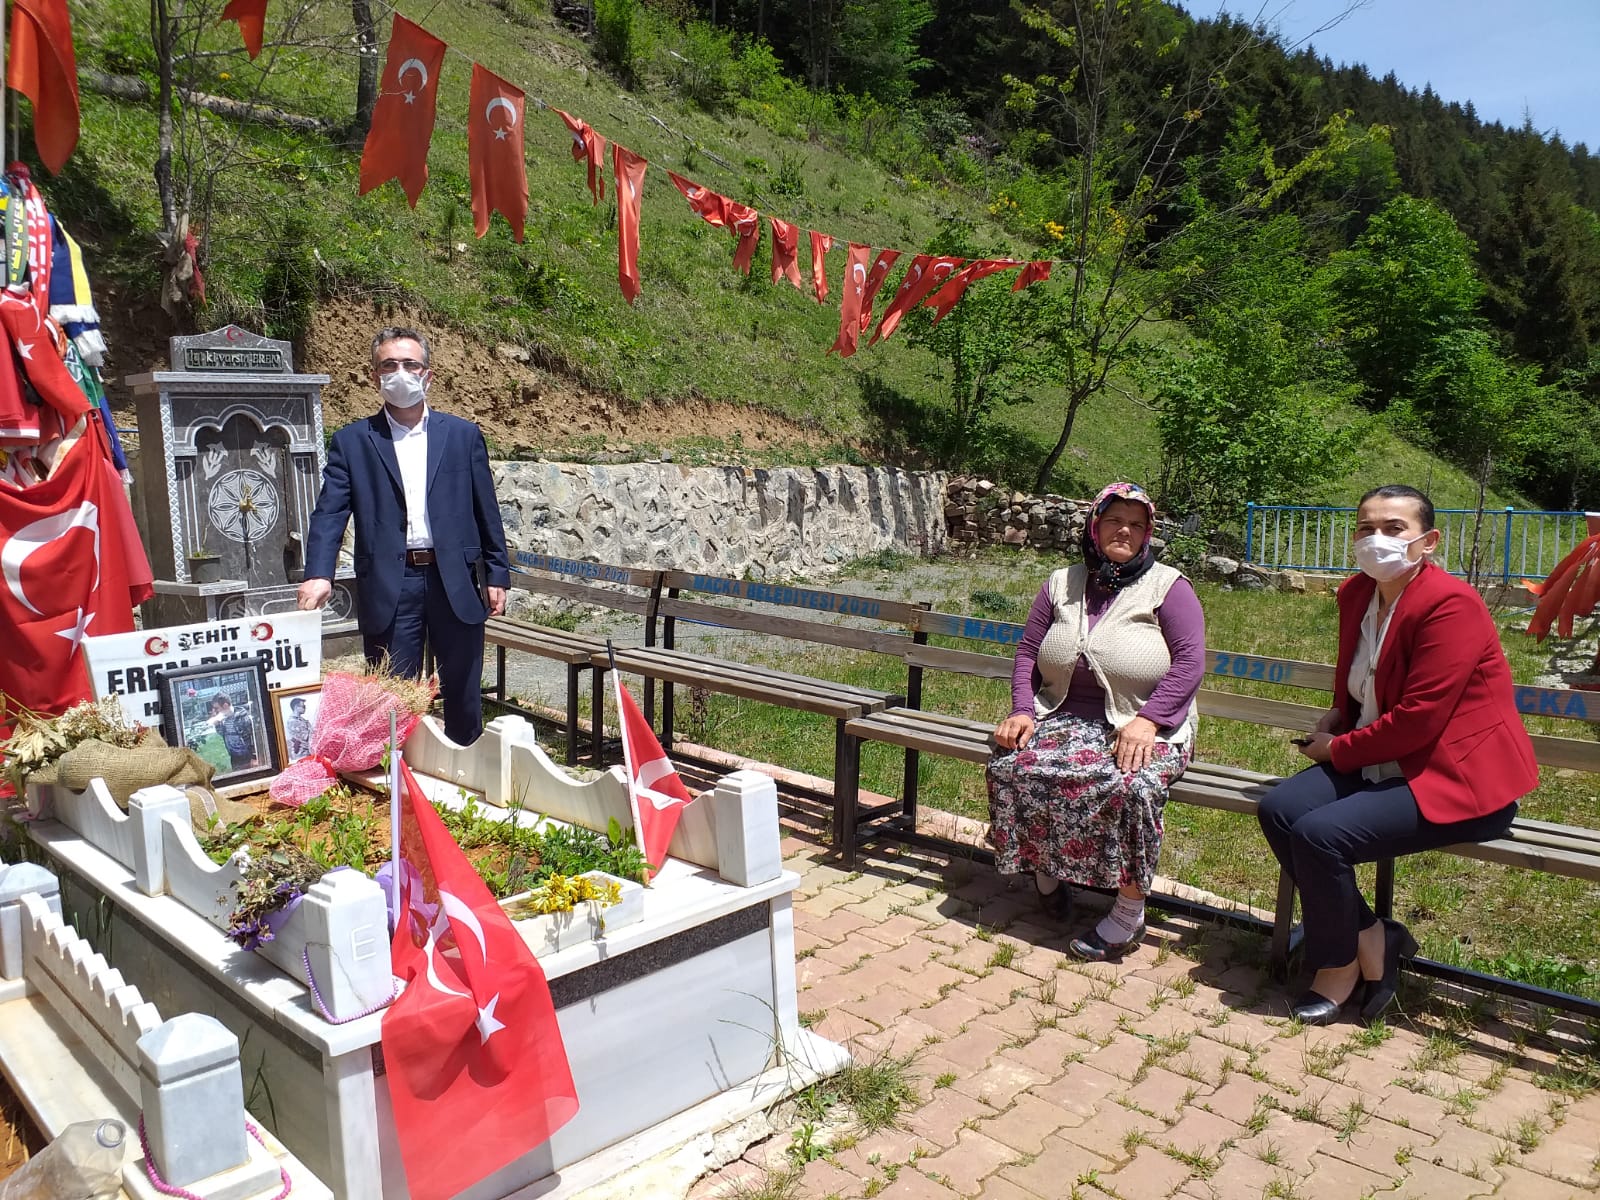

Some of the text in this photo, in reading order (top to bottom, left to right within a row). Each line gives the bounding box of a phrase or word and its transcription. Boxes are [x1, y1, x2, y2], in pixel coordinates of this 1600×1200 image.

[252, 352, 281, 364] EREN
[604, 566, 629, 584] 2020
[839, 595, 880, 617] 2020
[178, 625, 241, 651] ŞEHİT
[1213, 652, 1284, 683] 2020
[350, 924, 377, 962] E
